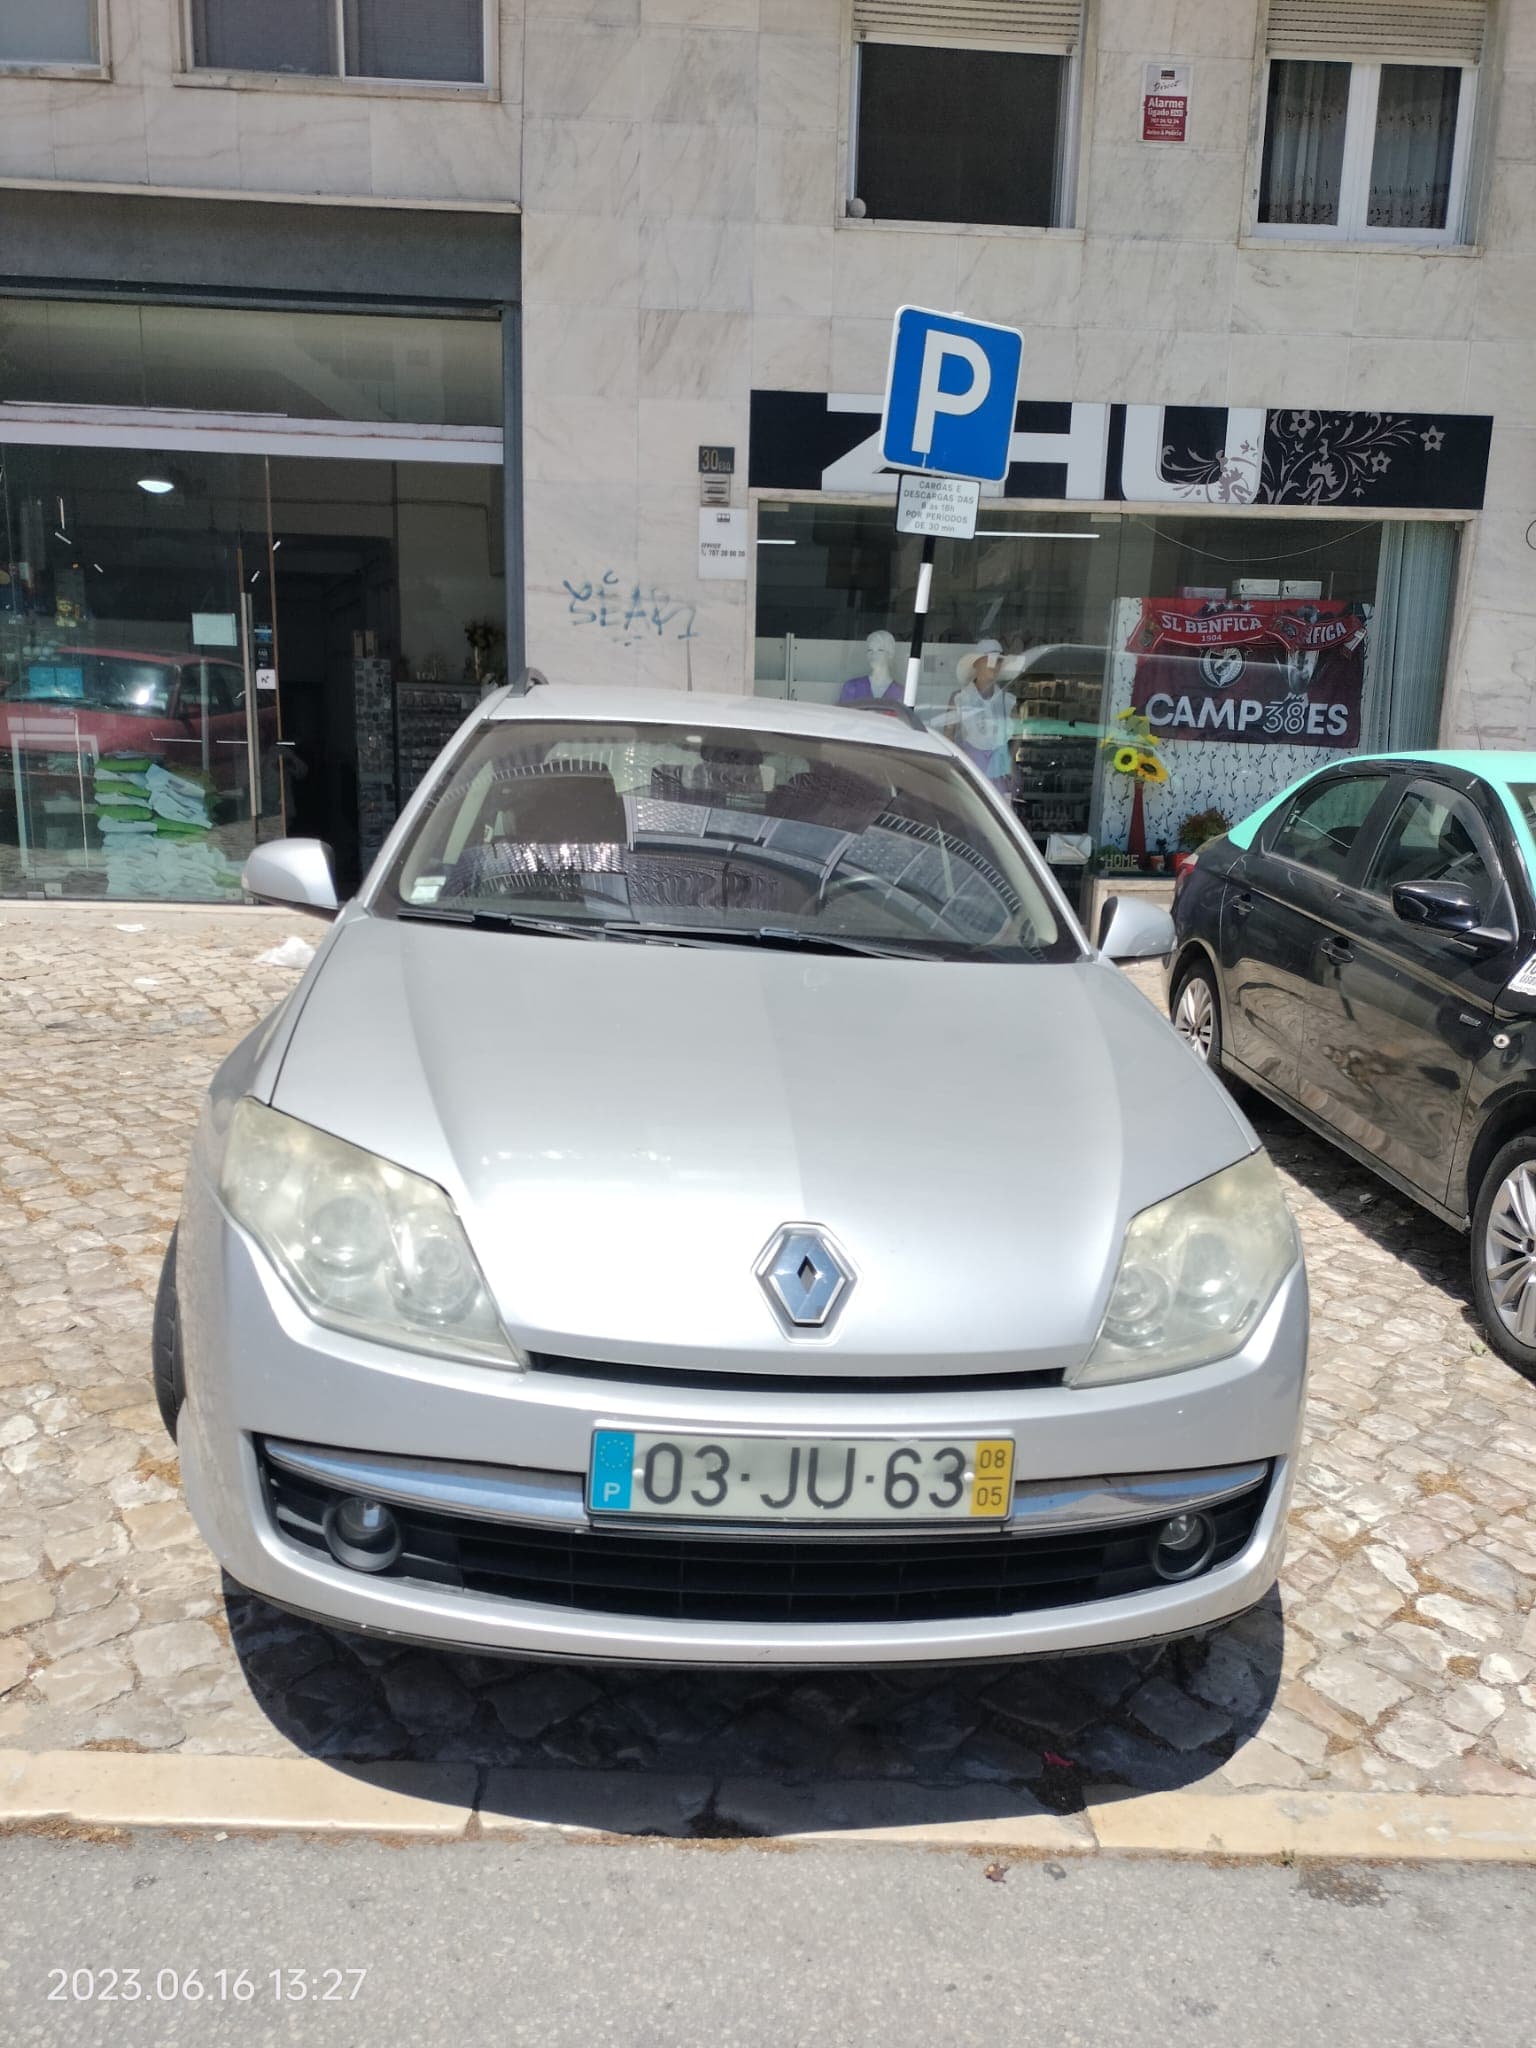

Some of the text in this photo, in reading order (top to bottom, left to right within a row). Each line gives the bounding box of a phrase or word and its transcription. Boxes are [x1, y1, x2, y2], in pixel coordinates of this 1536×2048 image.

[1148, 97, 1184, 108] Alarme
[911, 329, 991, 454] P
[703, 450, 718, 470] 30
[919, 481, 962, 493] CARGAS E
[904, 489, 974, 504] DESCARGAS DAS
[906, 510, 922, 519] POR
[914, 521, 926, 529] DE
[1162, 615, 1263, 633] SL BENFICA
[1201, 634, 1222, 642] 1904
[1105, 854, 1140, 868] HOME
[979, 1449, 1006, 1469] 08
[603, 1482, 621, 1502] P
[976, 1486, 1002, 1507] 05
